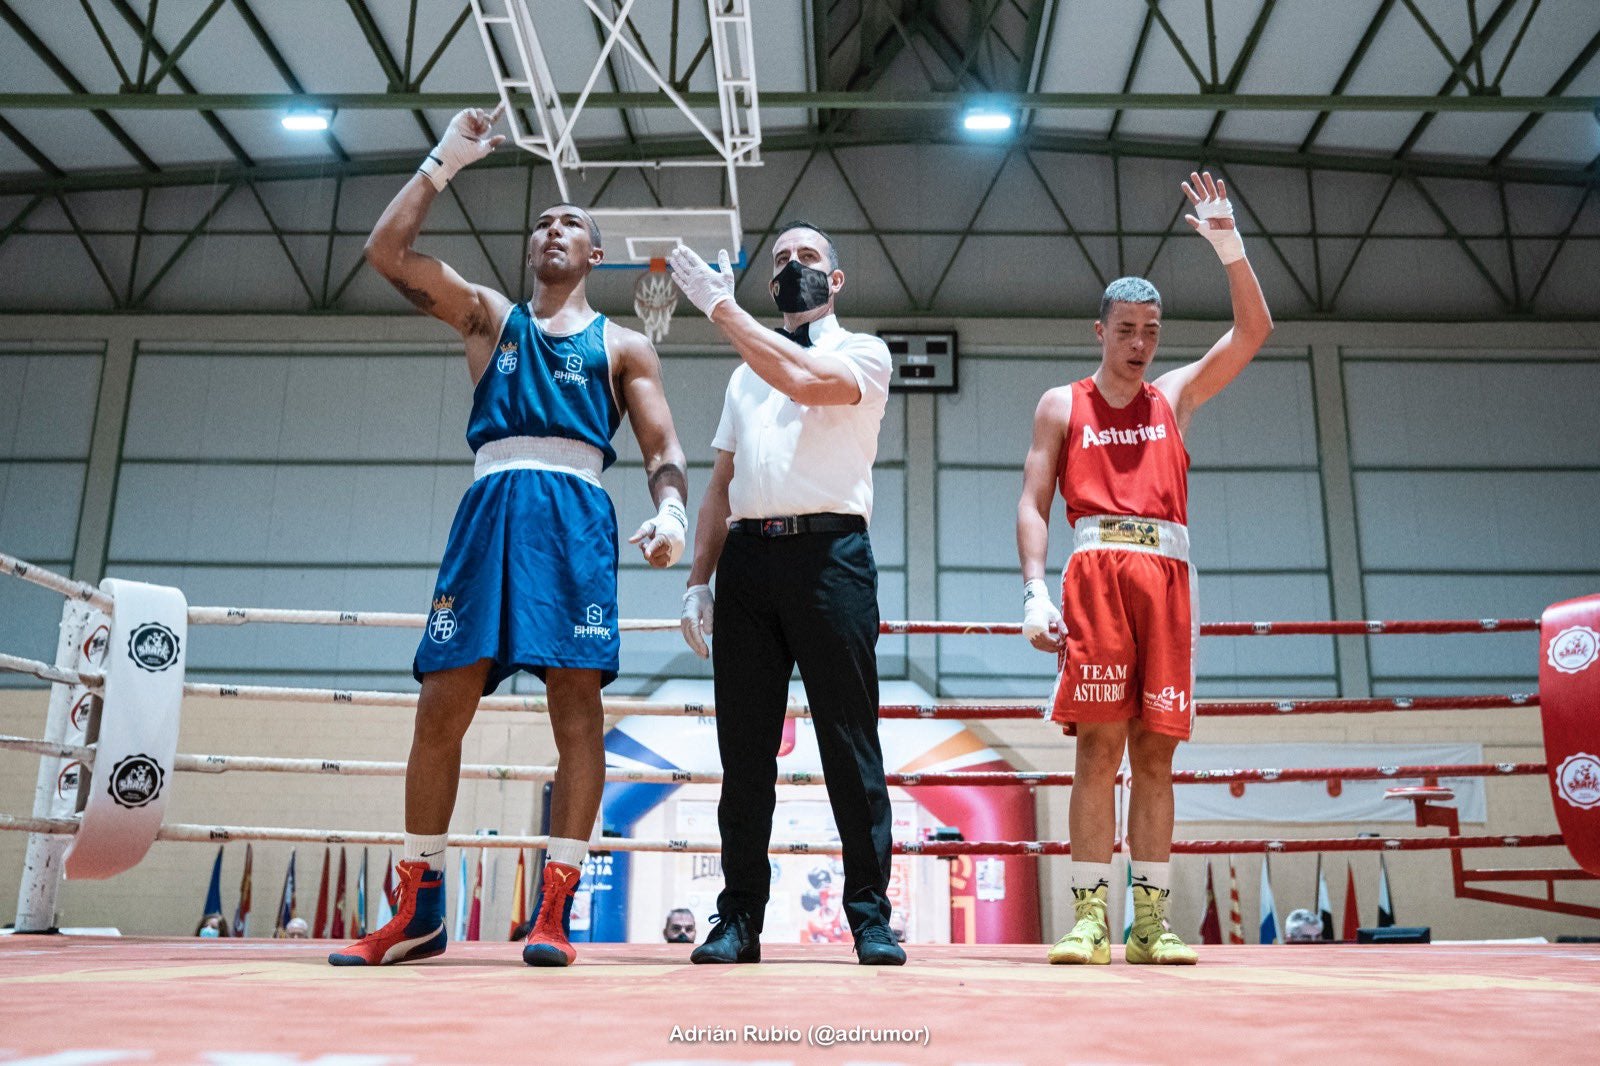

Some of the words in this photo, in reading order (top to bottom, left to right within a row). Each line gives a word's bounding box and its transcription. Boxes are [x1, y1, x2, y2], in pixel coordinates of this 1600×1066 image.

[554, 370, 588, 386] SHARK
[1082, 424, 1167, 449] Asturias
[574, 625, 611, 637] SHARK
[1080, 664, 1127, 680] TEAM
[684, 703, 704, 714] KING
[321, 761, 340, 772] KING
[672, 772, 692, 782] KING
